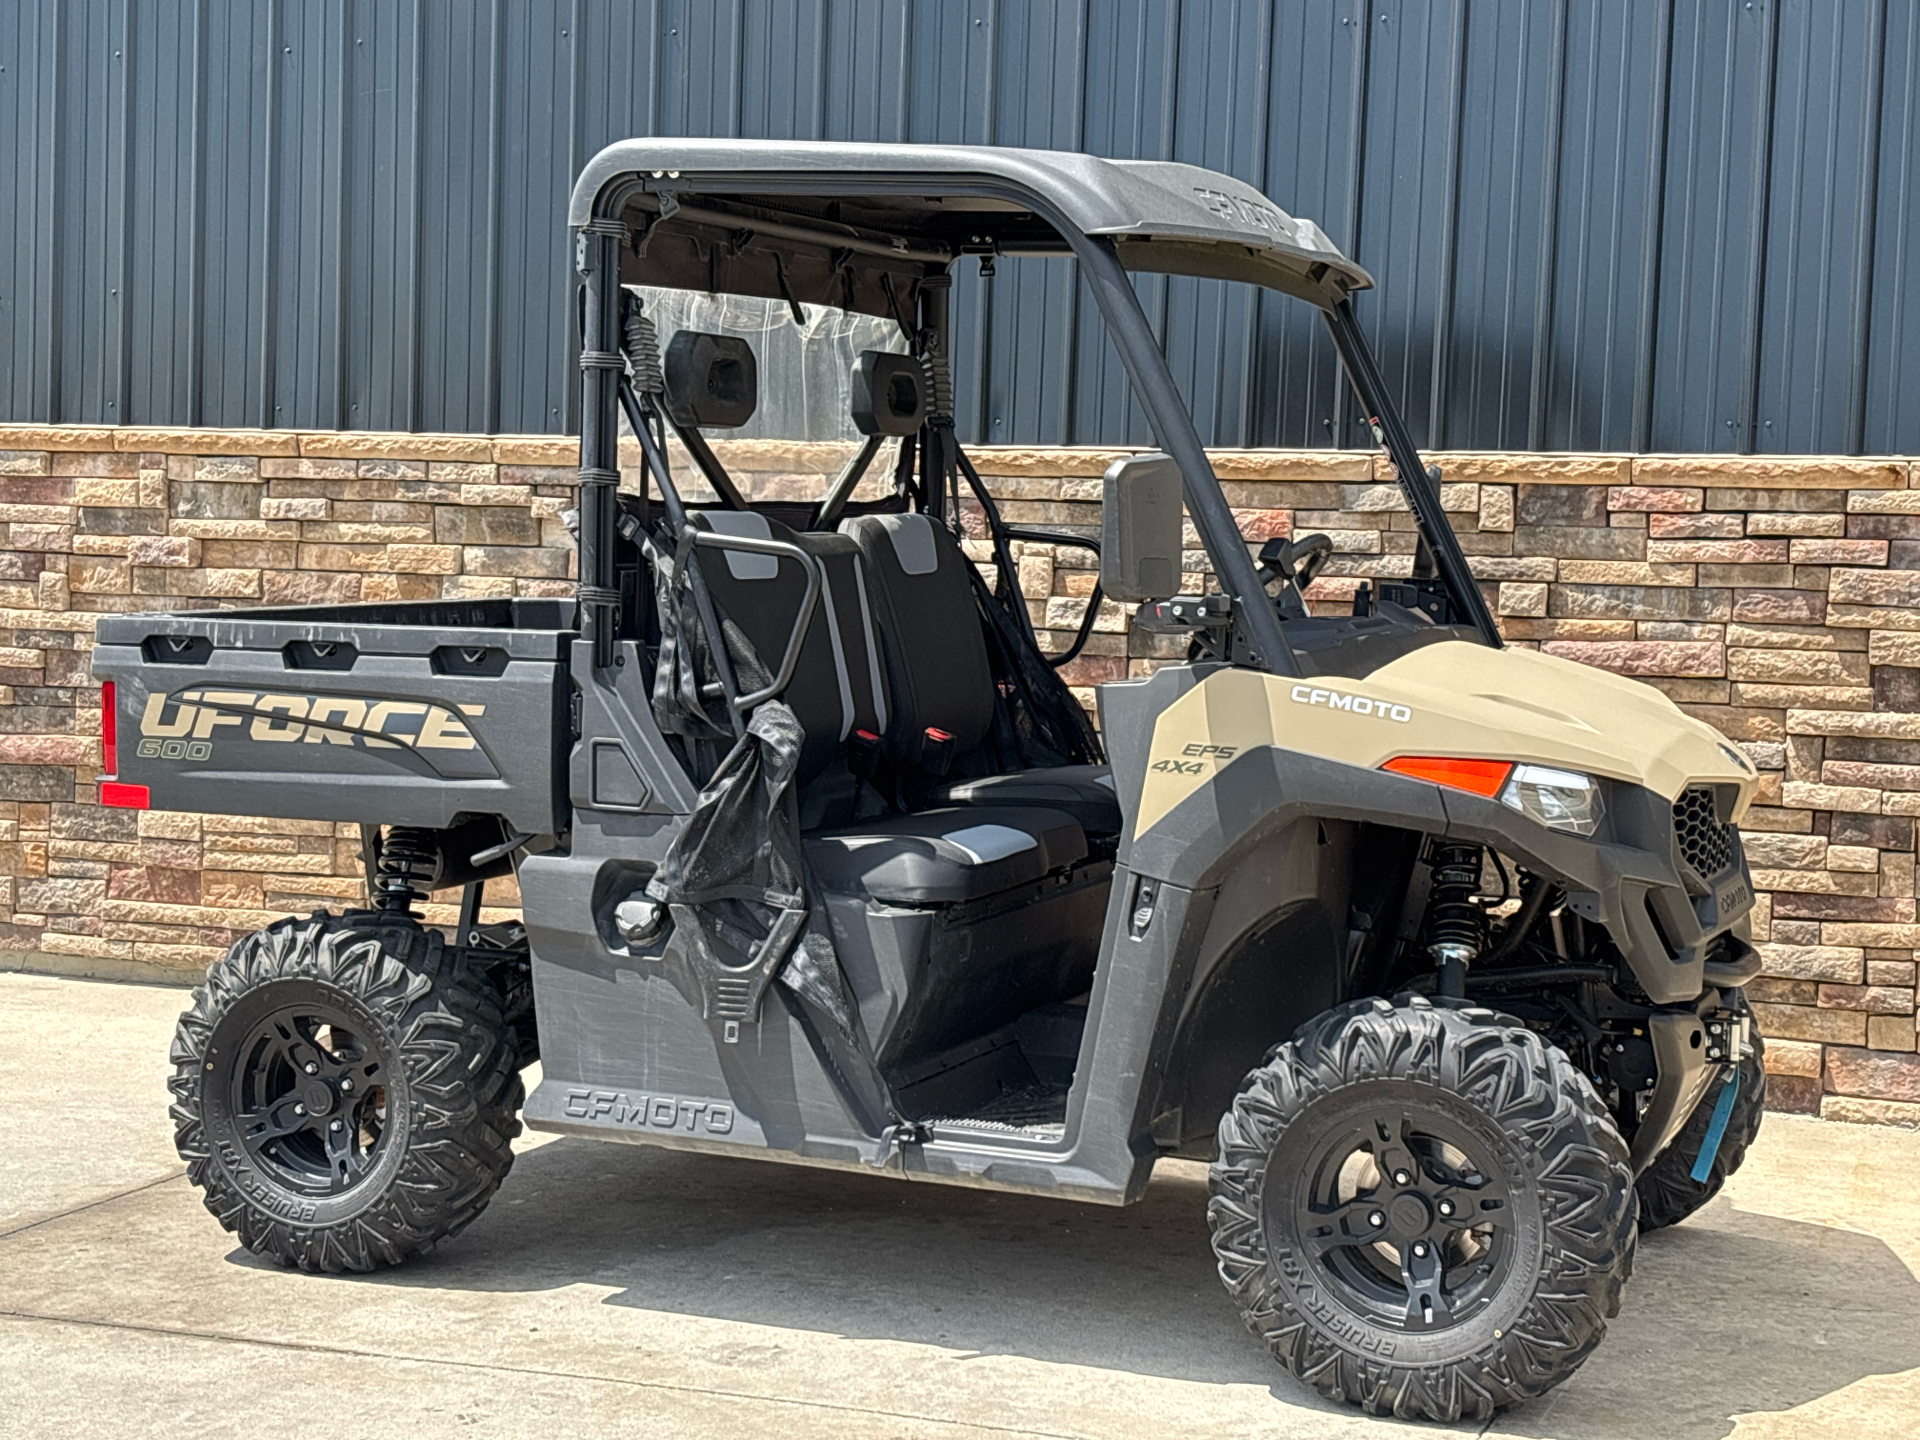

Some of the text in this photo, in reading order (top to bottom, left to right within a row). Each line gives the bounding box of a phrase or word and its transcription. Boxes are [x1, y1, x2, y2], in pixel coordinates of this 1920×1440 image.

[140, 692, 486, 750] UFORCE
[1291, 685, 1411, 723] CFMOTO
[136, 739, 213, 761] 600
[1182, 744, 1237, 759] EPS
[564, 1088, 735, 1135] CFMOTO
[243, 1174, 317, 1221] BRUISER
[1304, 1290, 1397, 1358] BRUISER
